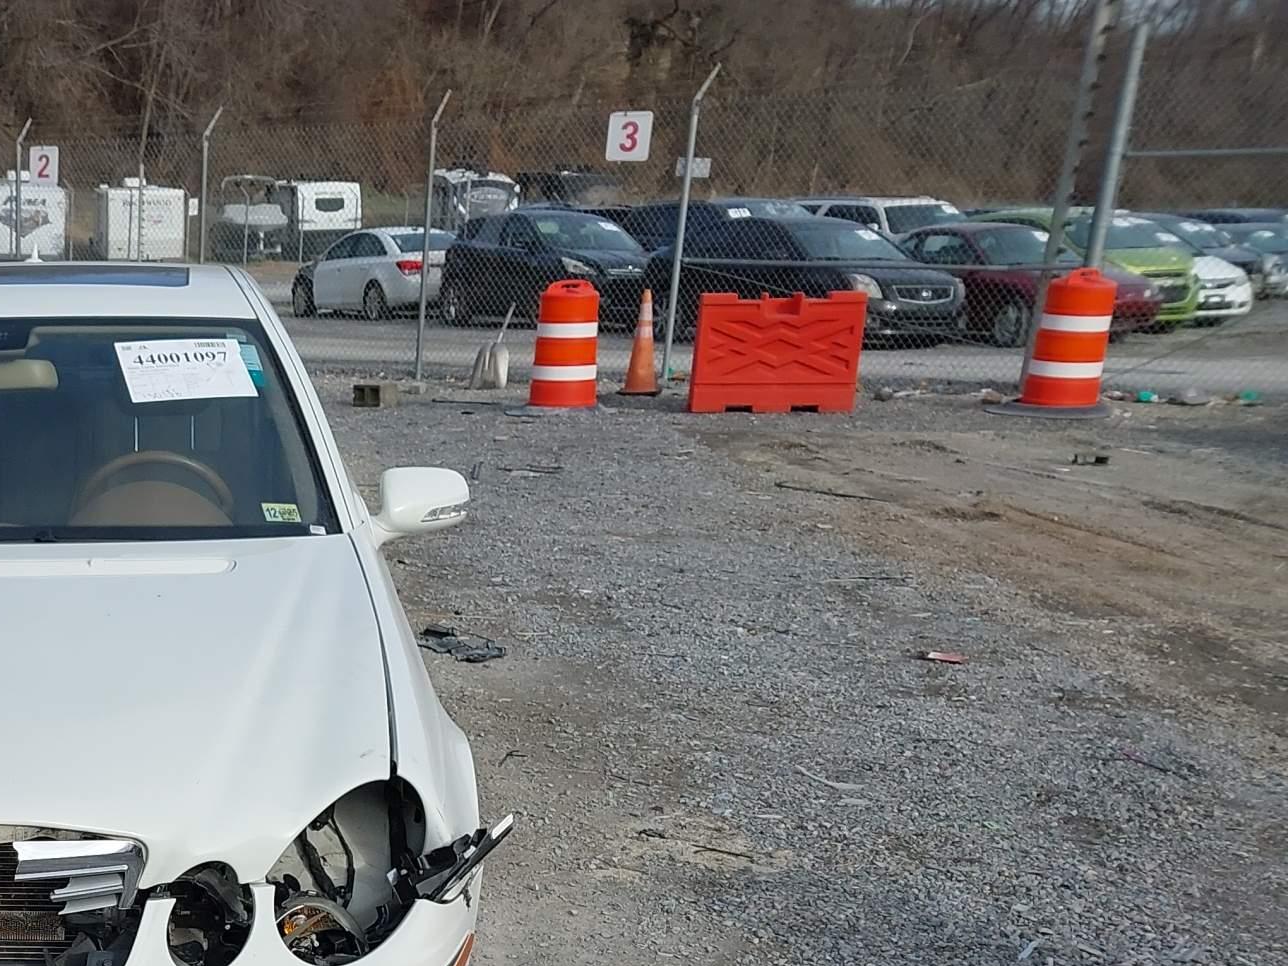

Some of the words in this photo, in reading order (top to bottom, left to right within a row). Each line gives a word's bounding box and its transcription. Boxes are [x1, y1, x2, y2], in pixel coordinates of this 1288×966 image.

[619, 120, 639, 152] 3
[38, 154, 50, 178] 2
[133, 352, 227, 365] 44001097
[265, 507, 279, 519] 12
